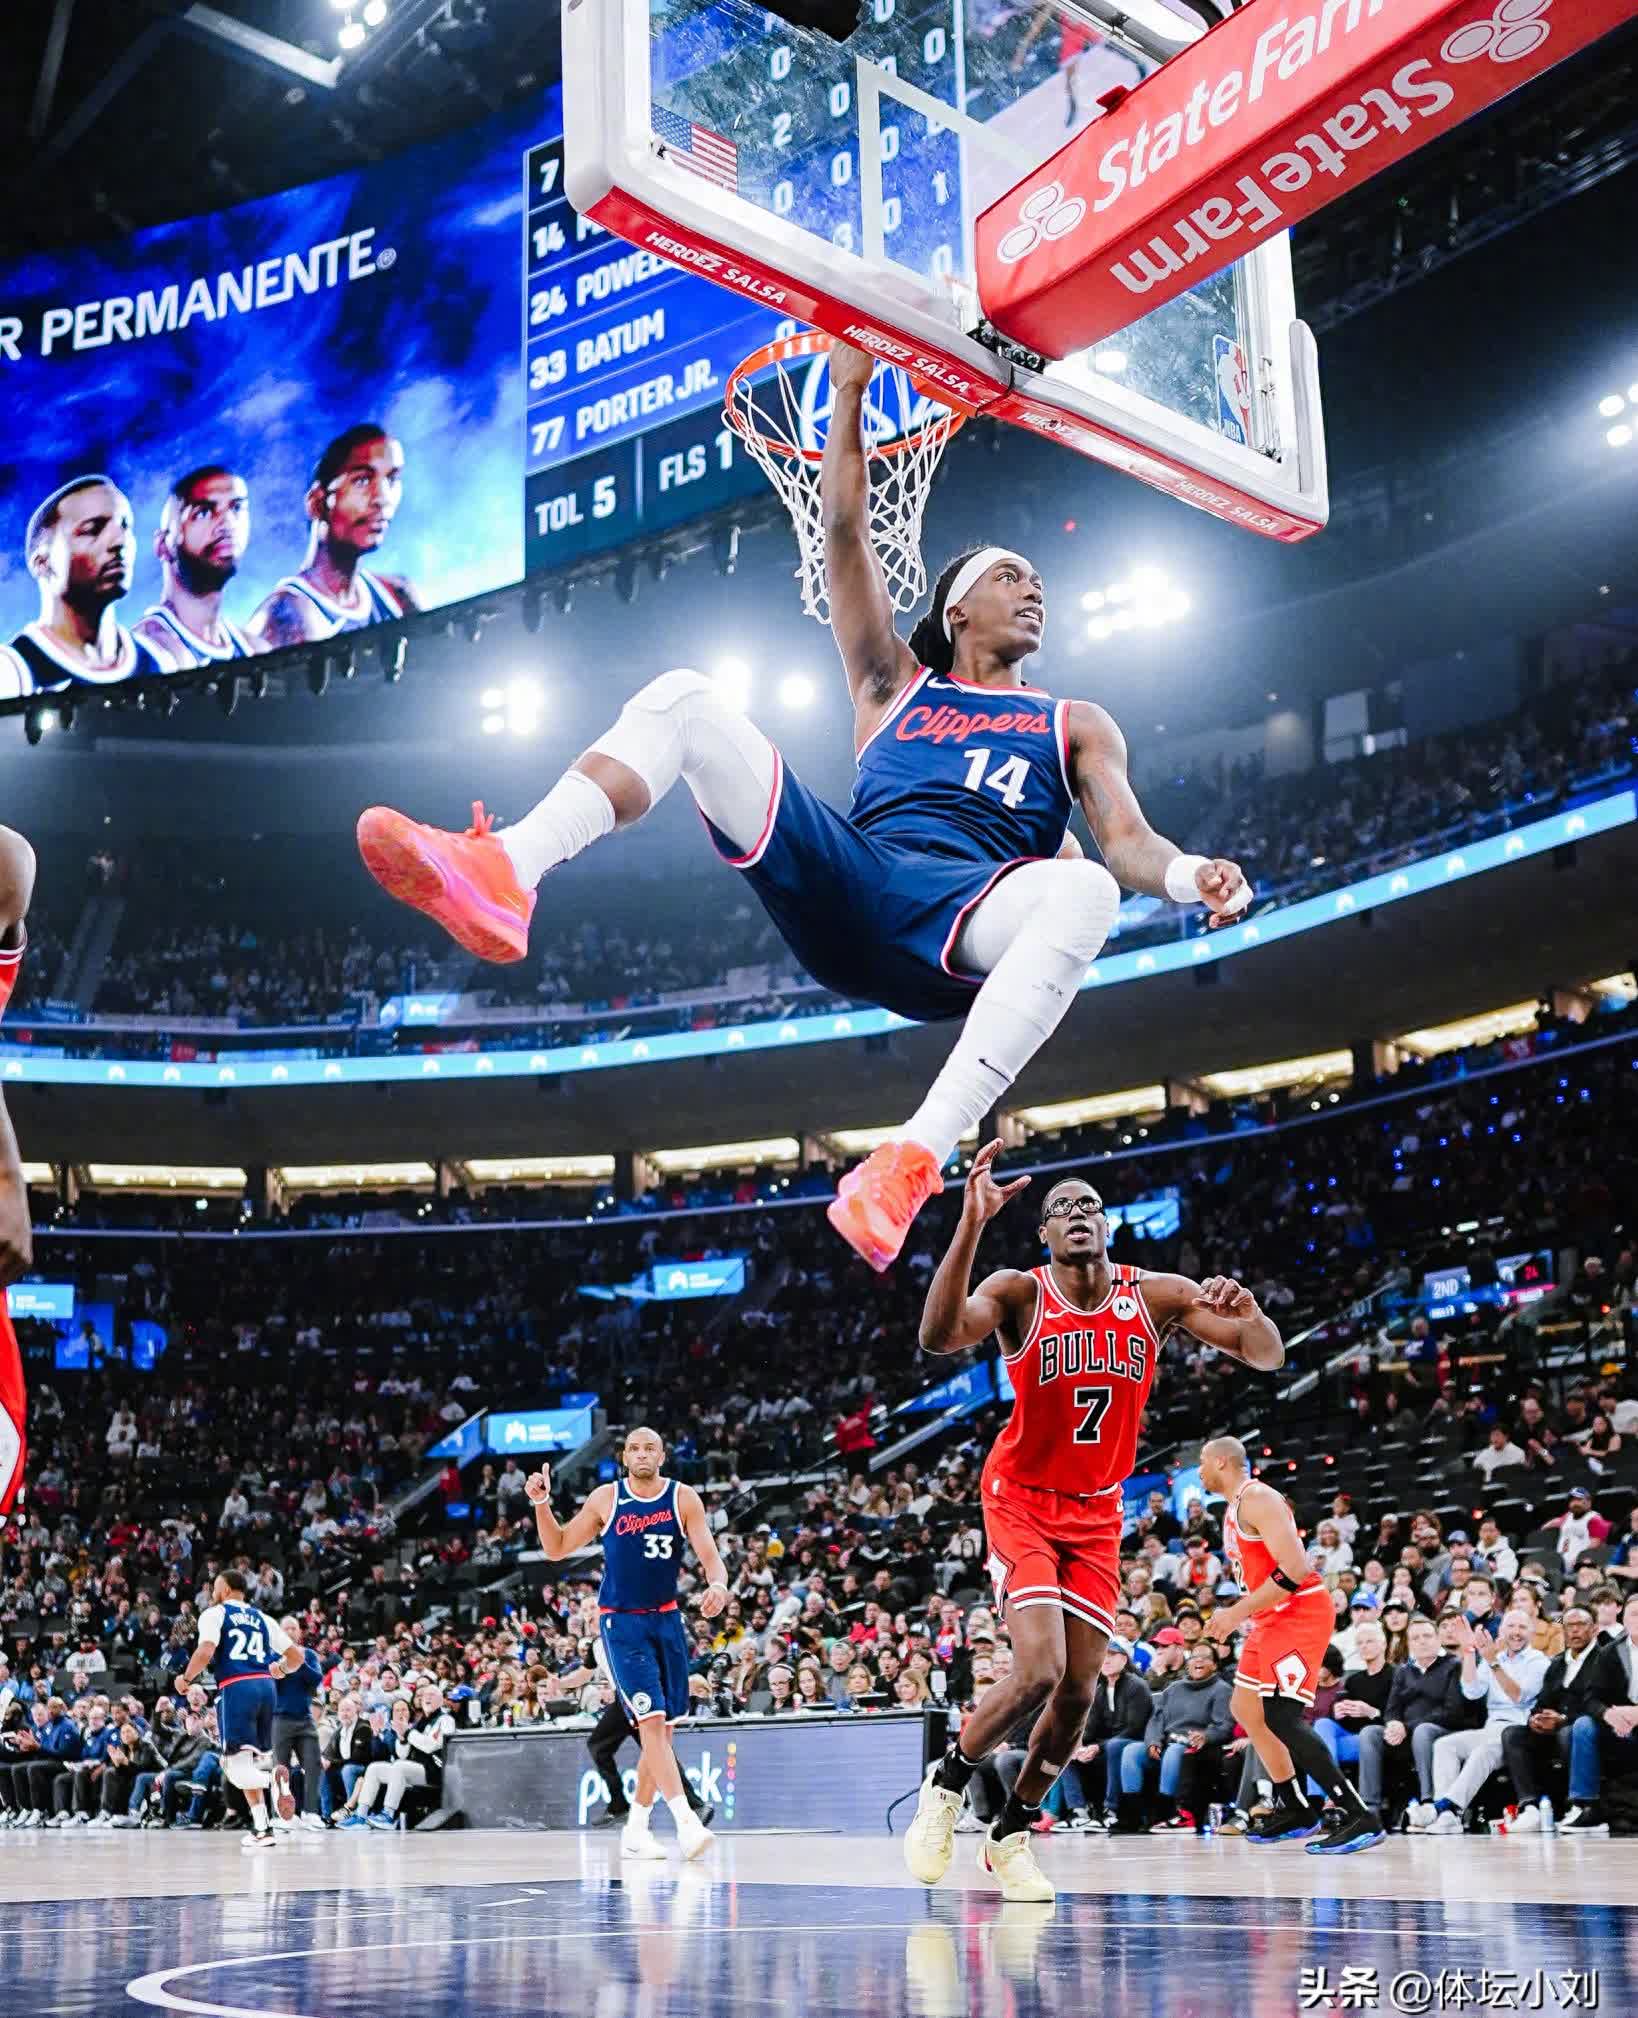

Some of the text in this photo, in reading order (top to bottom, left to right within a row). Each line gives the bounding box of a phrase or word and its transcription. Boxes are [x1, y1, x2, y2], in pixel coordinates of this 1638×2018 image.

[771, 46, 790, 80] 0
[773, 82, 850, 147] 2 0
[540, 158, 560, 194] 7
[831, 152, 852, 186] 0
[532, 221, 566, 259] 14
[645, 231, 786, 304] HERDEZ SALSA
[530, 285, 568, 325] 24
[528, 308, 665, 391] 33 BATUM
[843, 325, 969, 393] HERDEZ SALSA
[531, 415, 566, 456] 77
[576, 373, 674, 441] PORTER
[659, 429, 734, 492] FLS 1
[534, 475, 617, 536] TOL 5
[1229, 506, 1280, 532] SALSA
[896, 704, 1051, 744] Clippers
[963, 748, 1031, 799] 14
[1432, 1278, 1459, 1300] 2ND
[1039, 1329, 1147, 1387] BULLS
[1072, 1385, 1113, 1444] 7
[615, 1510, 673, 1536] Clippers
[643, 1533, 674, 1560] 33
[228, 1628, 267, 1663] 24
